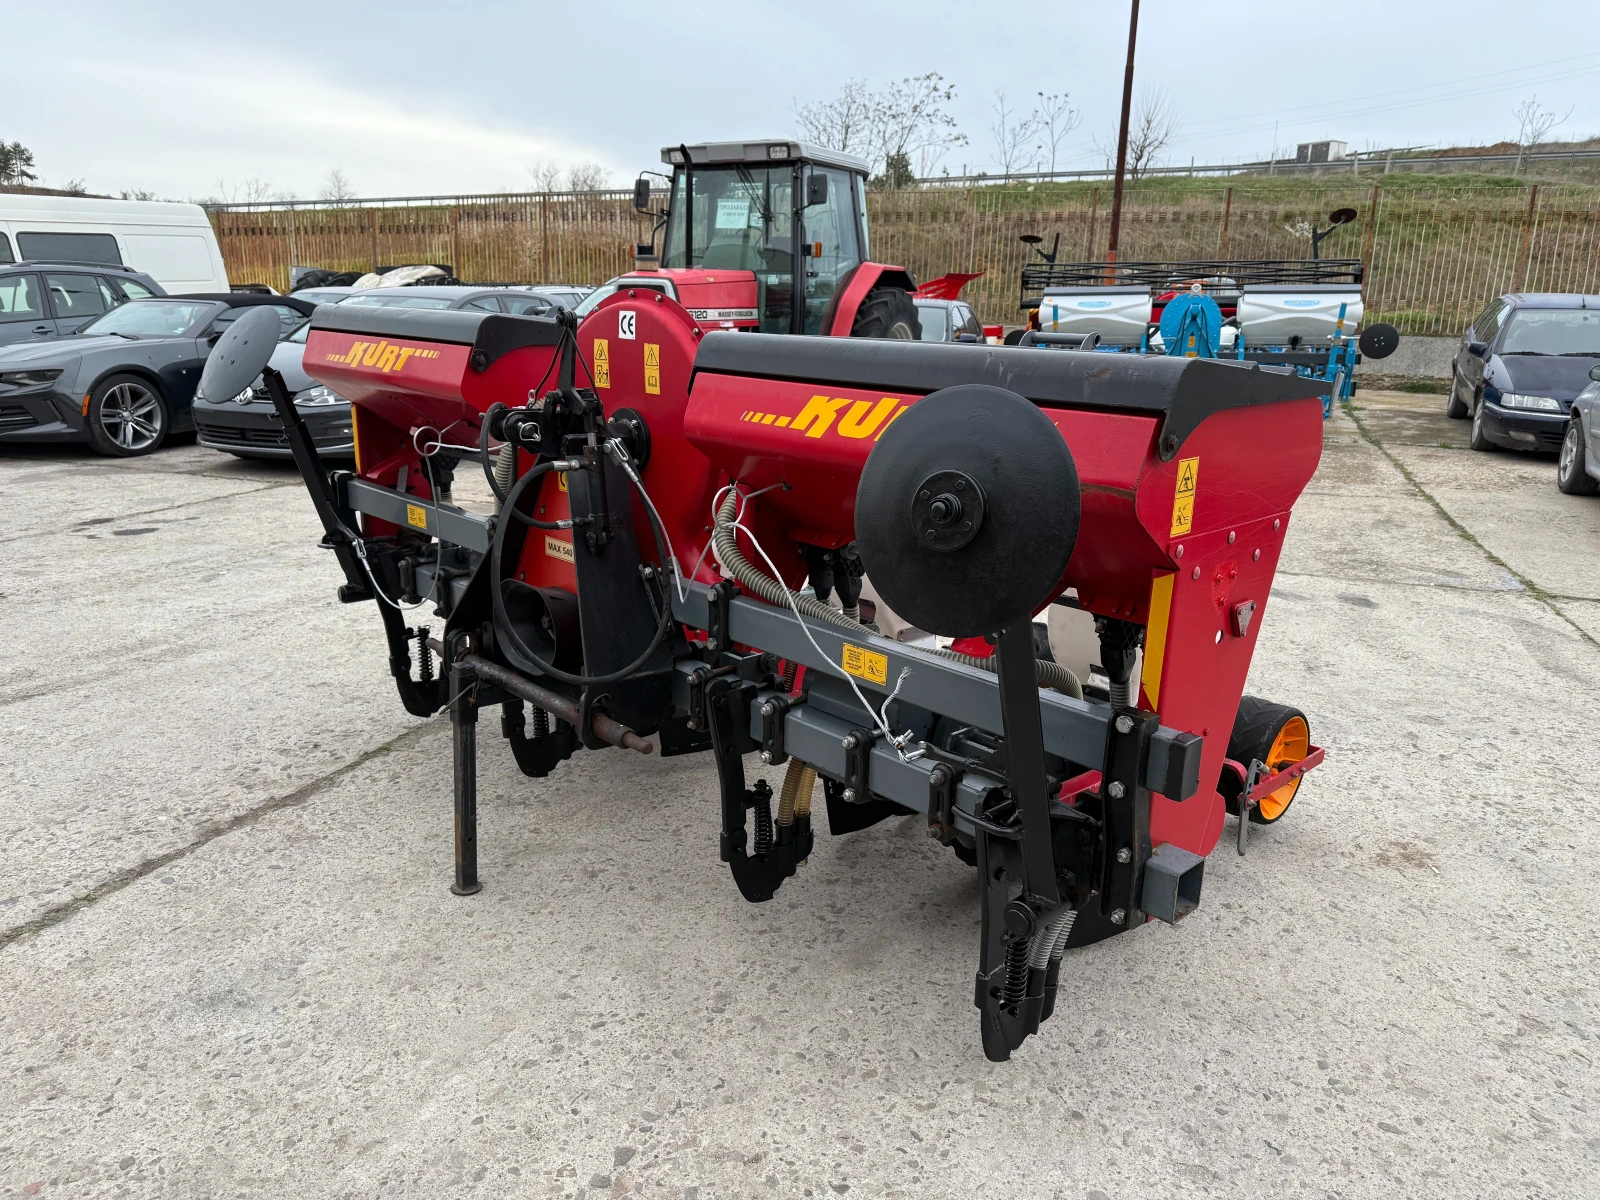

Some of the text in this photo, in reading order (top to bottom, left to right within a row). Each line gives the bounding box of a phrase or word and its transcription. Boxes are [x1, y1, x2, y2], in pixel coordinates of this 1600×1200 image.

[620, 314, 634, 336] CE
[734, 310, 753, 318] FERGUSON
[344, 340, 416, 373] KURT
[789, 395, 909, 441] KU
[548, 542, 573, 557] MAX 540
